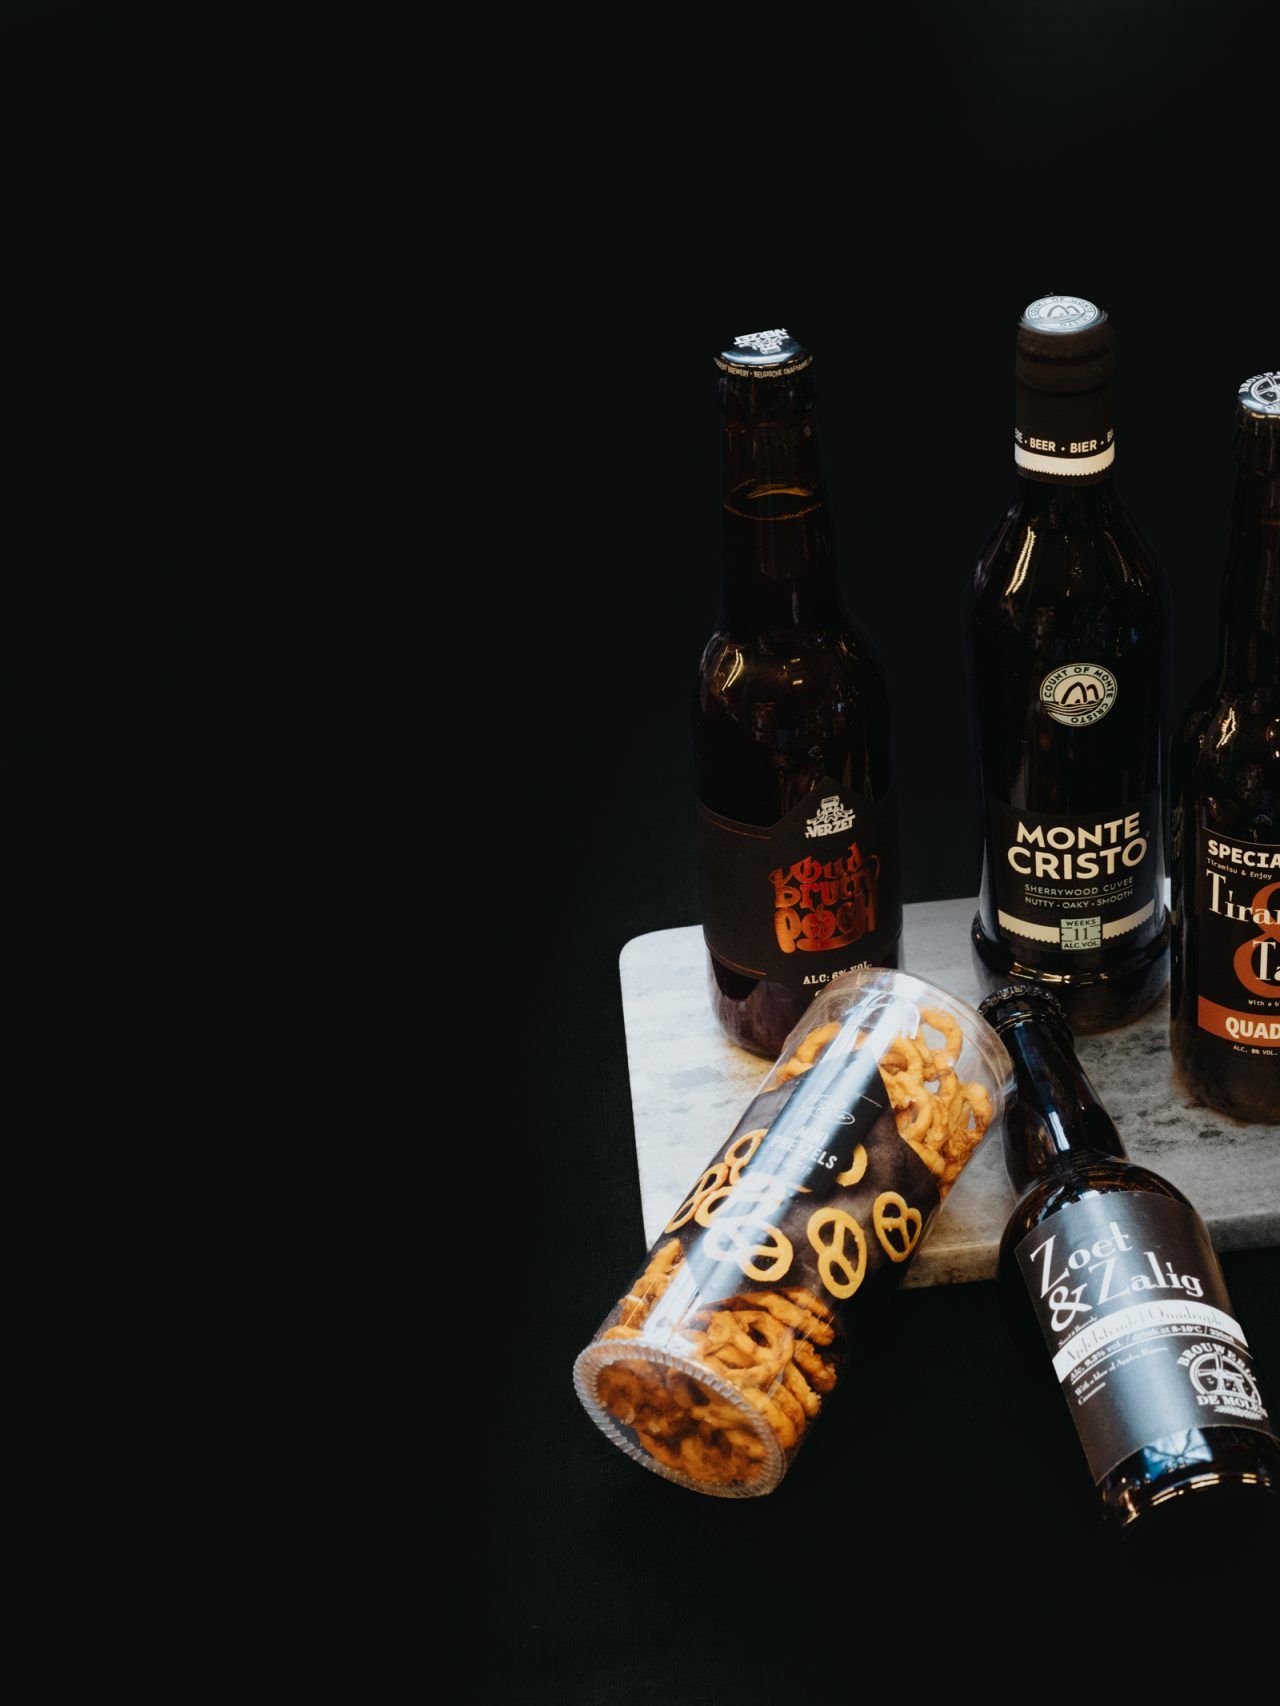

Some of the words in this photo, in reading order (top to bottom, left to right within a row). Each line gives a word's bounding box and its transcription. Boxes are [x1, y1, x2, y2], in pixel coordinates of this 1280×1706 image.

[1029, 437, 1057, 453] BEER
[1069, 439, 1098, 454] BIER
[1073, 666, 1090, 674] OF
[1044, 670, 1068, 698] COUNT
[1094, 670, 1114, 698] MONTE
[1070, 703, 1109, 724] CRISTO
[807, 814, 856, 838] VERZET
[1016, 811, 1141, 851] MONTE
[1007, 837, 1148, 880] CRISTO
[1250, 871, 1273, 880] Enjoy
[1024, 883, 1099, 897] SHERRYWOOD
[1103, 876, 1134, 893] CUVEE
[1024, 896, 1055, 909] NUTTY
[1062, 900, 1090, 910] OAKY
[1096, 889, 1134, 907] SMOOTH
[1065, 918, 1097, 927] WEEKS
[1073, 927, 1089, 941] 11
[803, 974, 831, 985] ALC:
[1233, 1045, 1249, 1054] ALC.
[1029, 1221, 1133, 1299] Zoet
[1047, 1283, 1093, 1333] &
[1087, 1251, 1204, 1306] Zalig
[1195, 1395, 1220, 1406] DE
